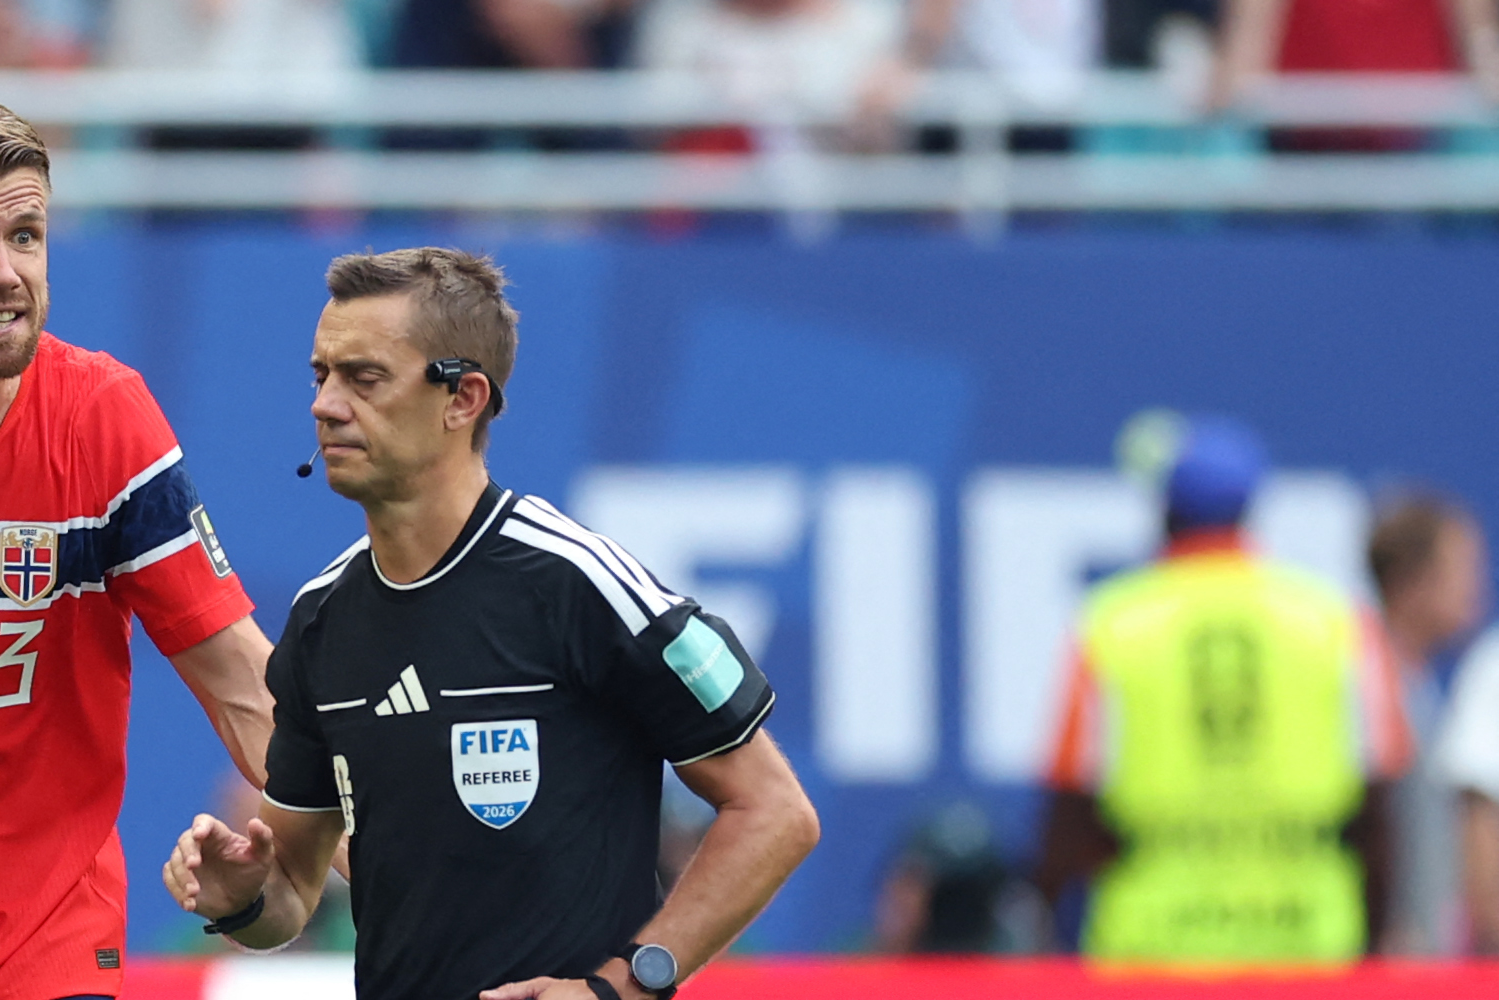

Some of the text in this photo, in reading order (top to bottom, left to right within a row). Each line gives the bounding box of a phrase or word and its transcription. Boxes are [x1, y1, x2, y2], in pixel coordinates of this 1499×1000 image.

[460, 727, 531, 756] FIFA
[462, 769, 532, 786] REFEREE
[482, 804, 516, 819] 2026
